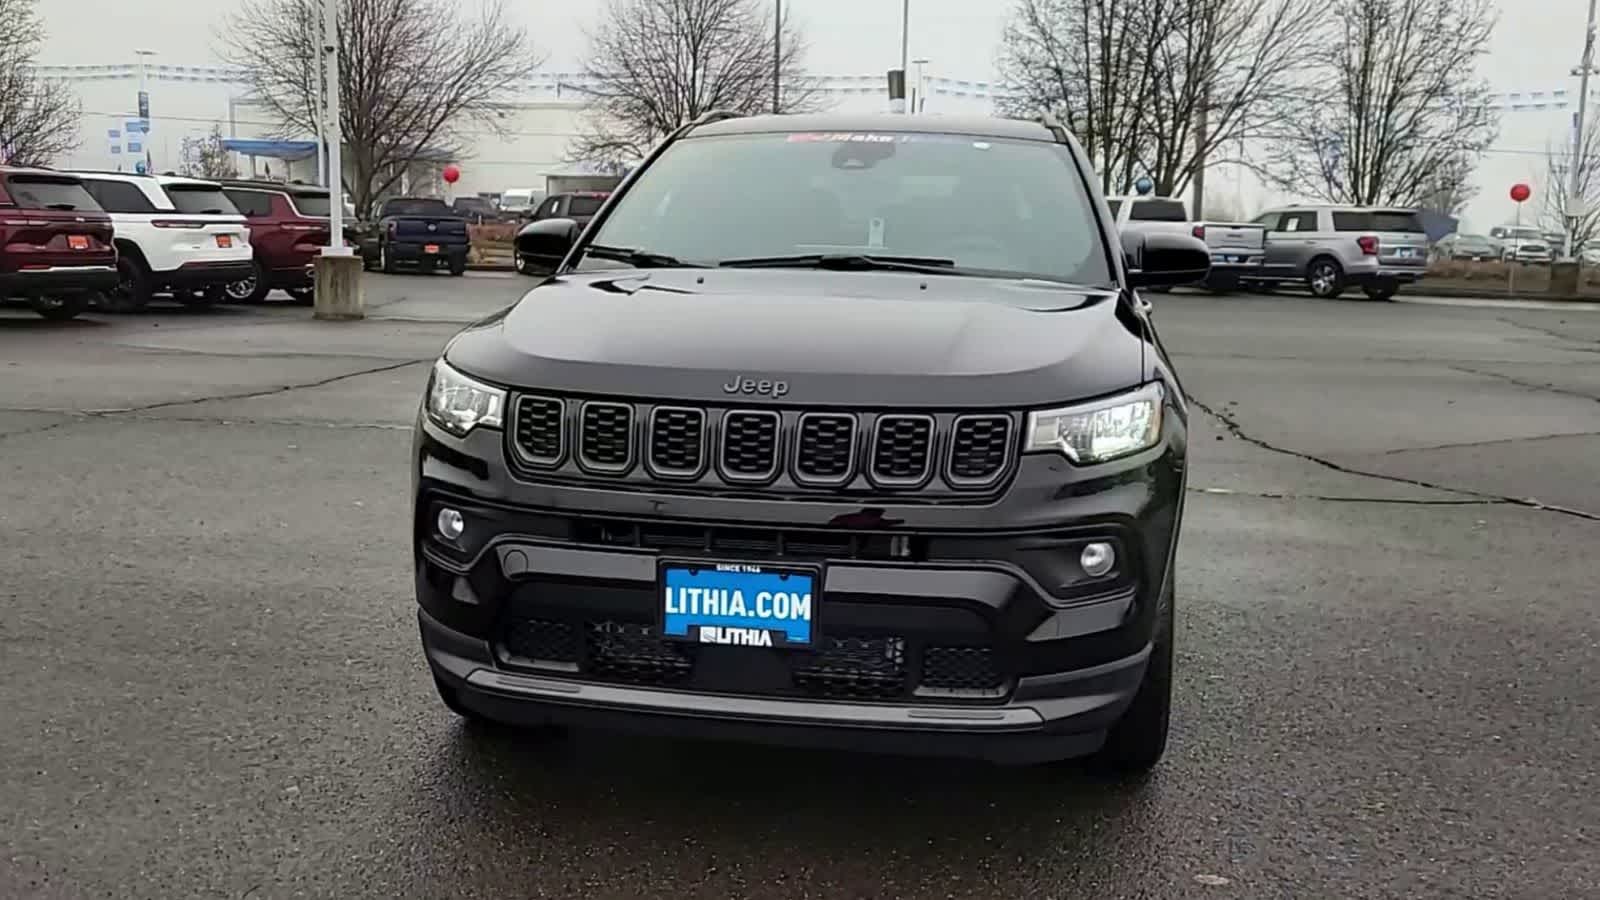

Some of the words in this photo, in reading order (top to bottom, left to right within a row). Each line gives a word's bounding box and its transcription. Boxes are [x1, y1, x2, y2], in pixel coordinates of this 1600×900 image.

[723, 375, 789, 399] Jeep
[716, 563, 740, 572] SINCE
[665, 586, 811, 620] LITHIA.COM
[716, 627, 773, 647] LITHIA
